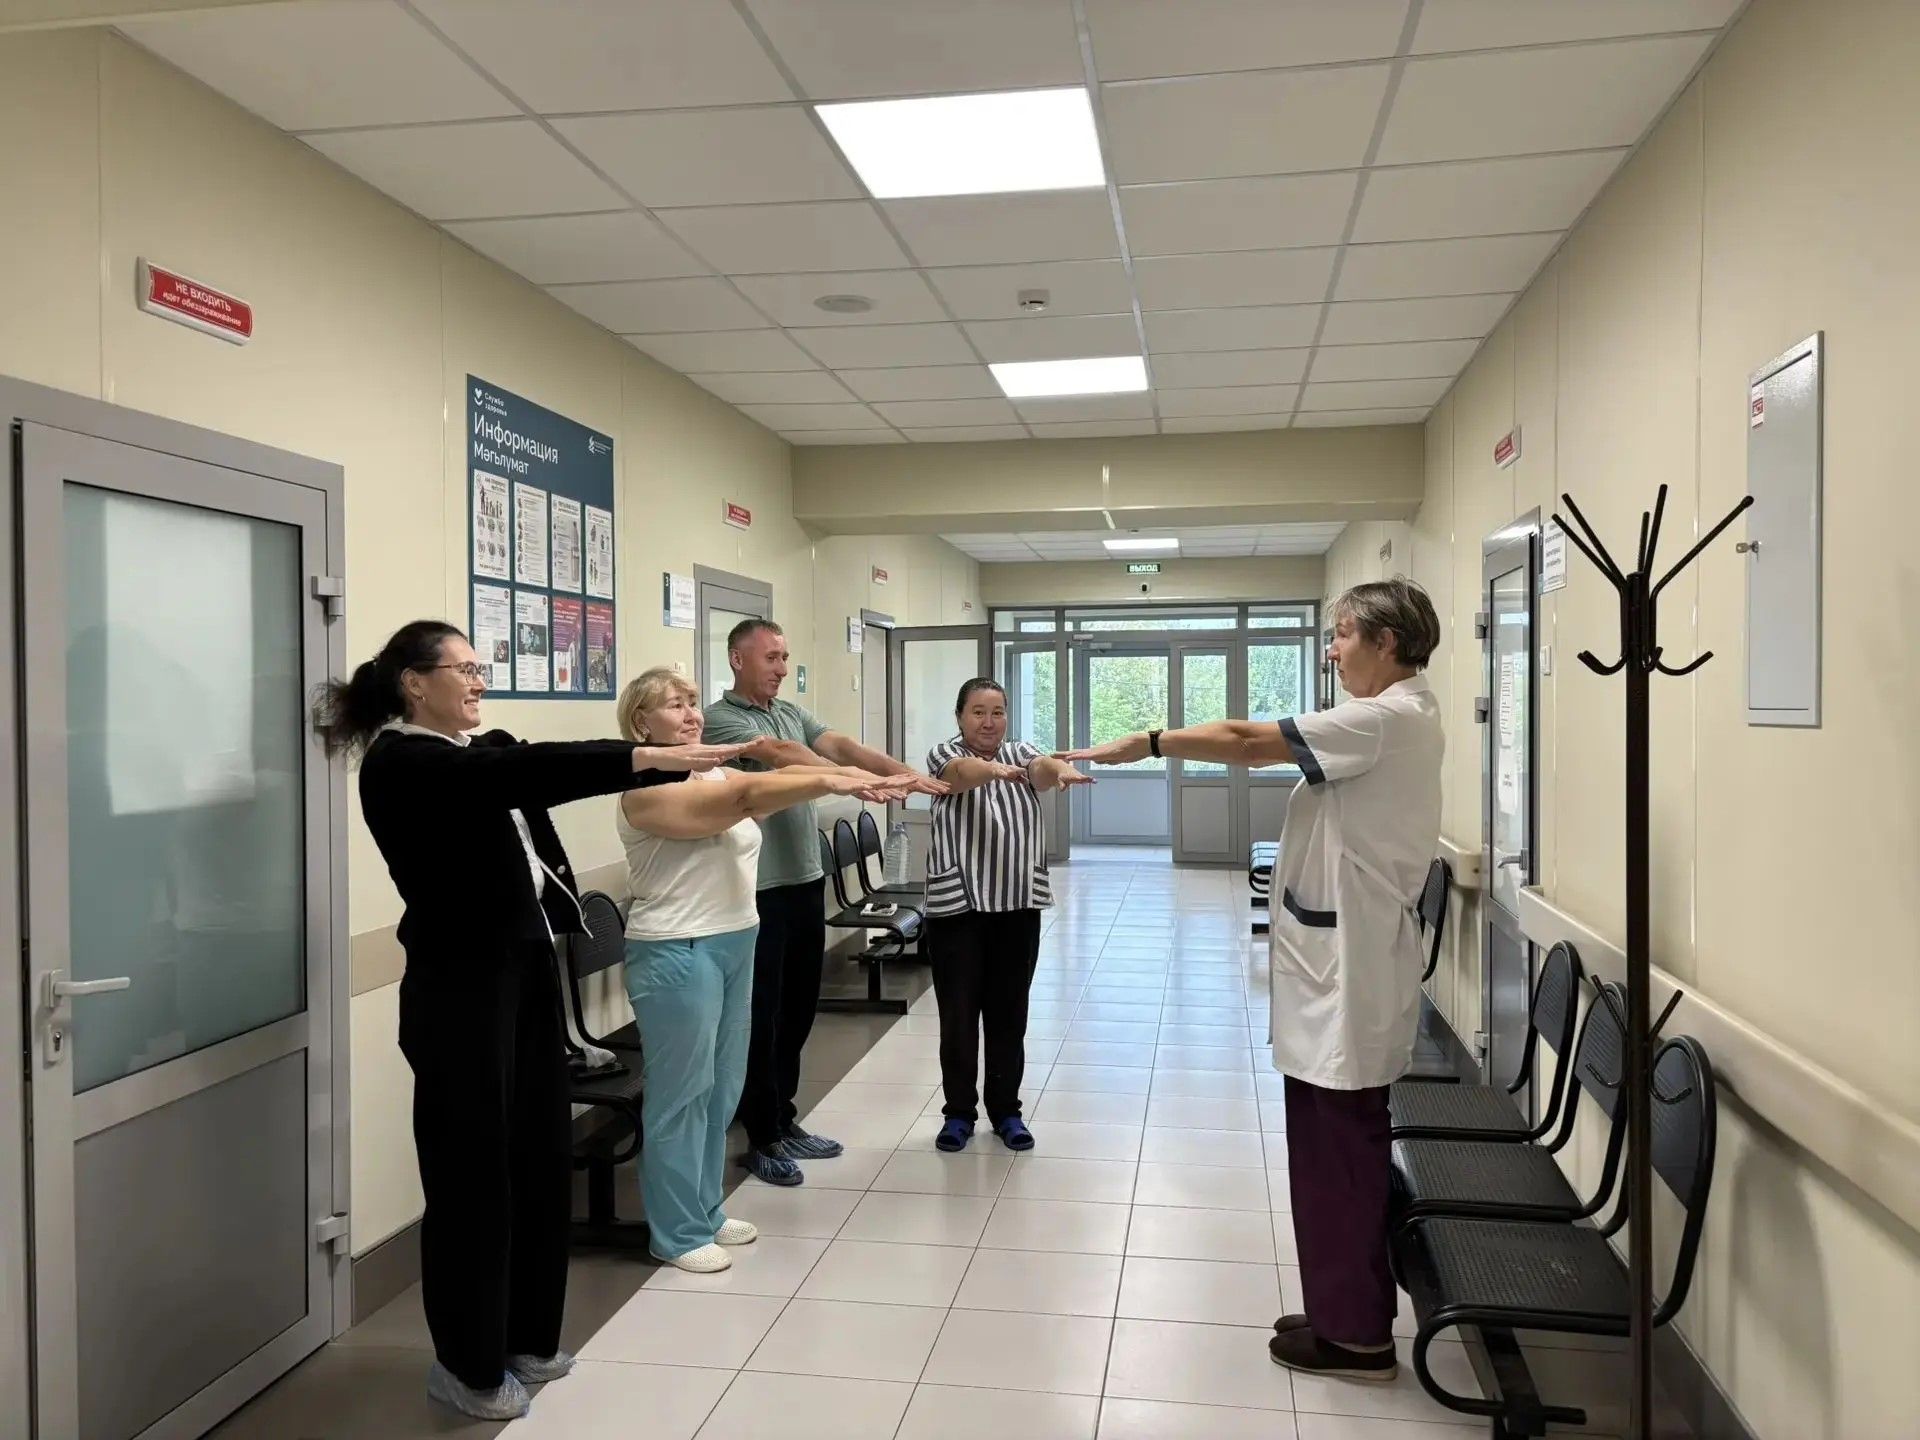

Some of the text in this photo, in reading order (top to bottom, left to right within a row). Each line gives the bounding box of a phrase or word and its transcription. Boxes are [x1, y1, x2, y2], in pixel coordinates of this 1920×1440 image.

[175, 281, 231, 312] НЕ ВХОДИТЬ
[474, 411, 559, 465] Информация
[1129, 564, 1158, 572] ВЫХОД
